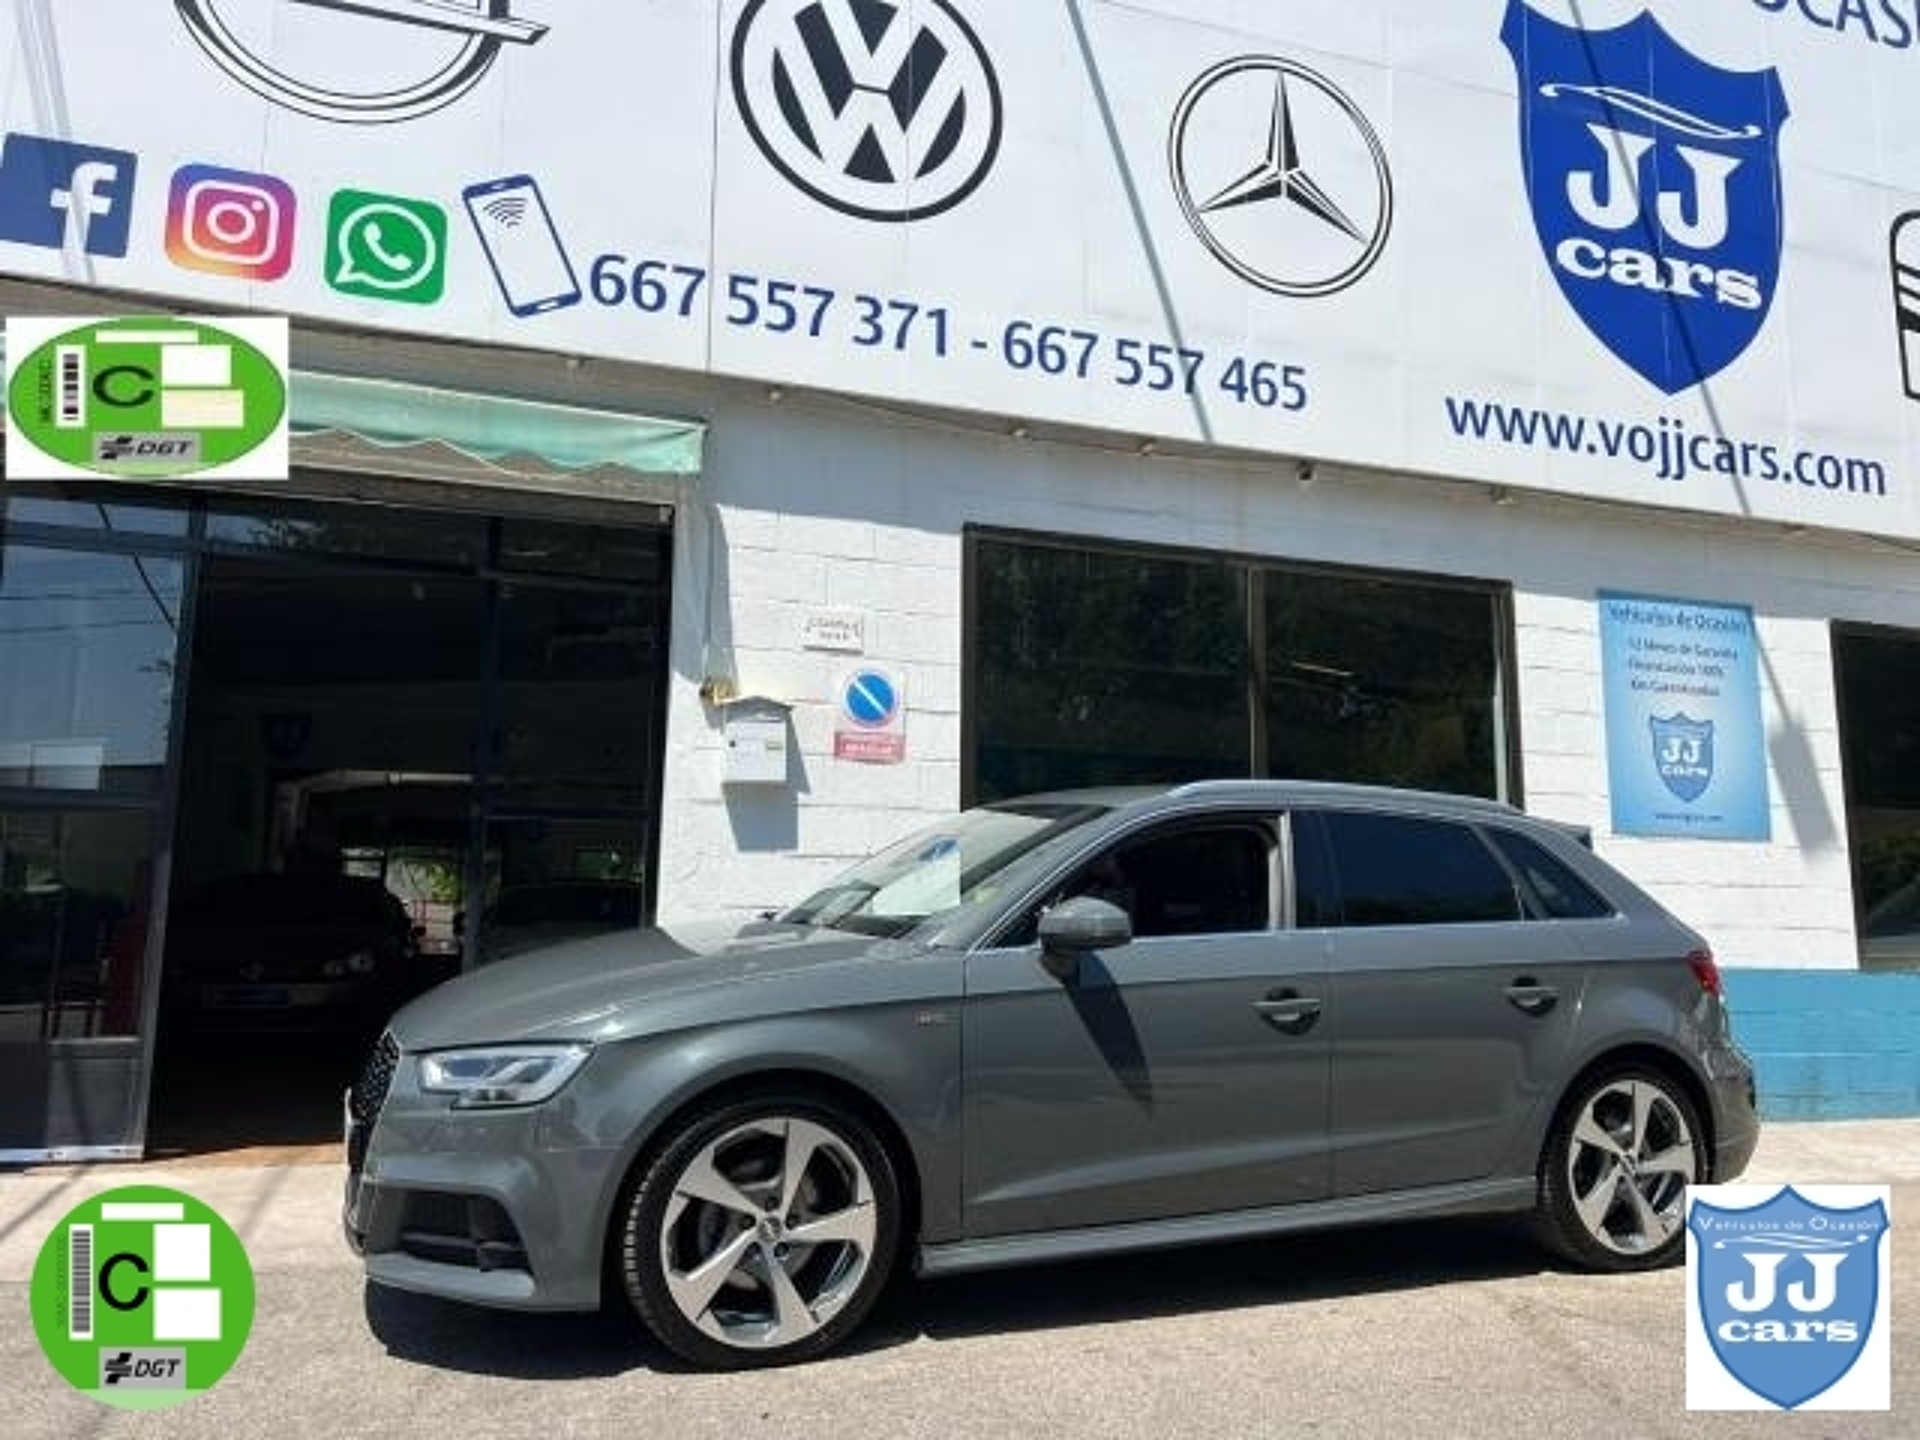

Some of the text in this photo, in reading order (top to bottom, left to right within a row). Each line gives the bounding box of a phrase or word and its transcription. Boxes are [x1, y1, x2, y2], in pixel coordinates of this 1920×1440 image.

[1566, 122, 1742, 250] JJ
[1555, 238, 1762, 310] cars
[590, 254, 706, 316] 667
[727, 274, 836, 338] 557
[853, 295, 948, 357] 371
[1003, 321, 1099, 378] 667
[1116, 338, 1205, 397] 557
[1219, 357, 1308, 411] 465
[1445, 396, 1886, 496] www.vojjcars.com
[1661, 736, 1702, 764] JJ
